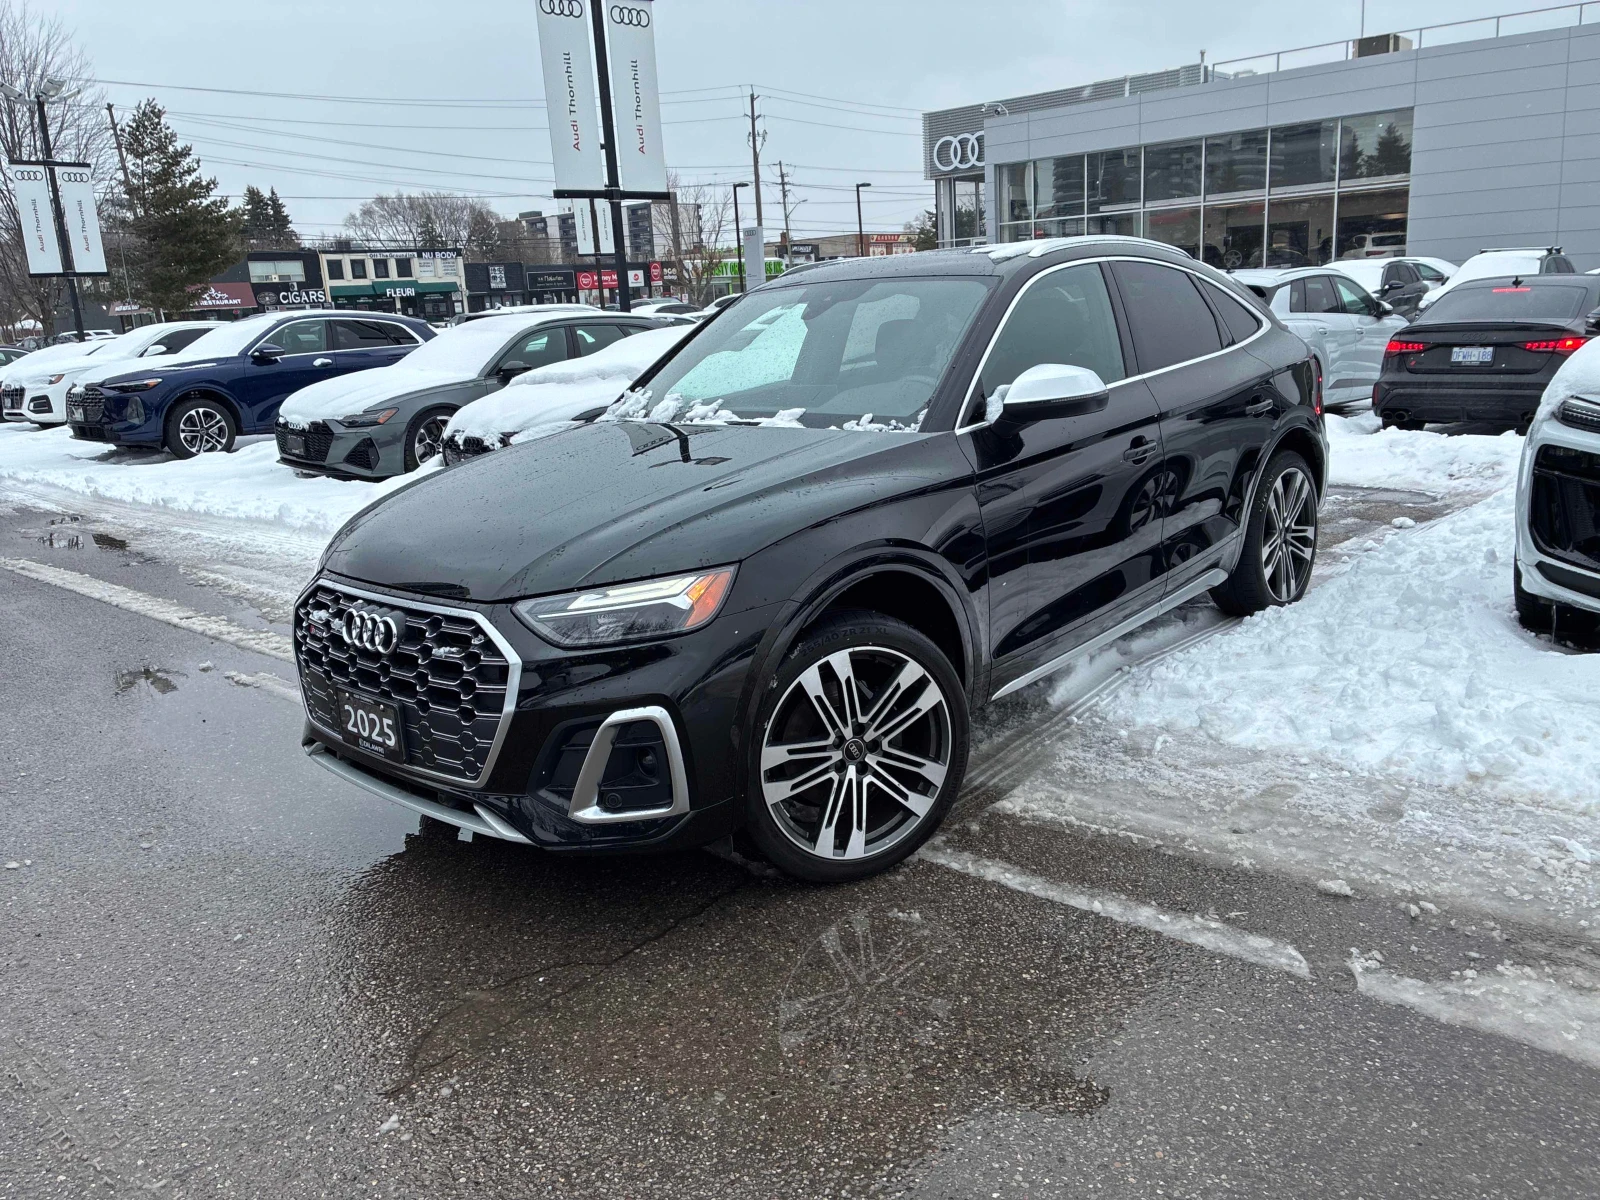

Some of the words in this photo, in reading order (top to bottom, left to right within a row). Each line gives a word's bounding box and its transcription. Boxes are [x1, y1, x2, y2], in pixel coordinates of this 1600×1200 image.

[563, 51, 576, 116] Thornhill
[630, 59, 642, 120] Thornhill
[570, 120, 580, 151] Audi
[636, 124, 645, 154] Audi
[31, 198, 42, 233] Thornhill
[77, 200, 87, 233] Thornhill
[37, 235, 45, 252] Audi
[82, 235, 91, 252] Audi
[422, 251, 434, 259] NU
[435, 251, 457, 259] BODY
[200, 298, 242, 306] RESTAURANT
[279, 290, 326, 304] CIGARS
[386, 287, 415, 298] FLEURI
[799, 632, 839, 657] 255/40
[841, 628, 858, 638] ZR
[875, 626, 889, 636] XL
[344, 704, 396, 747] 2025
